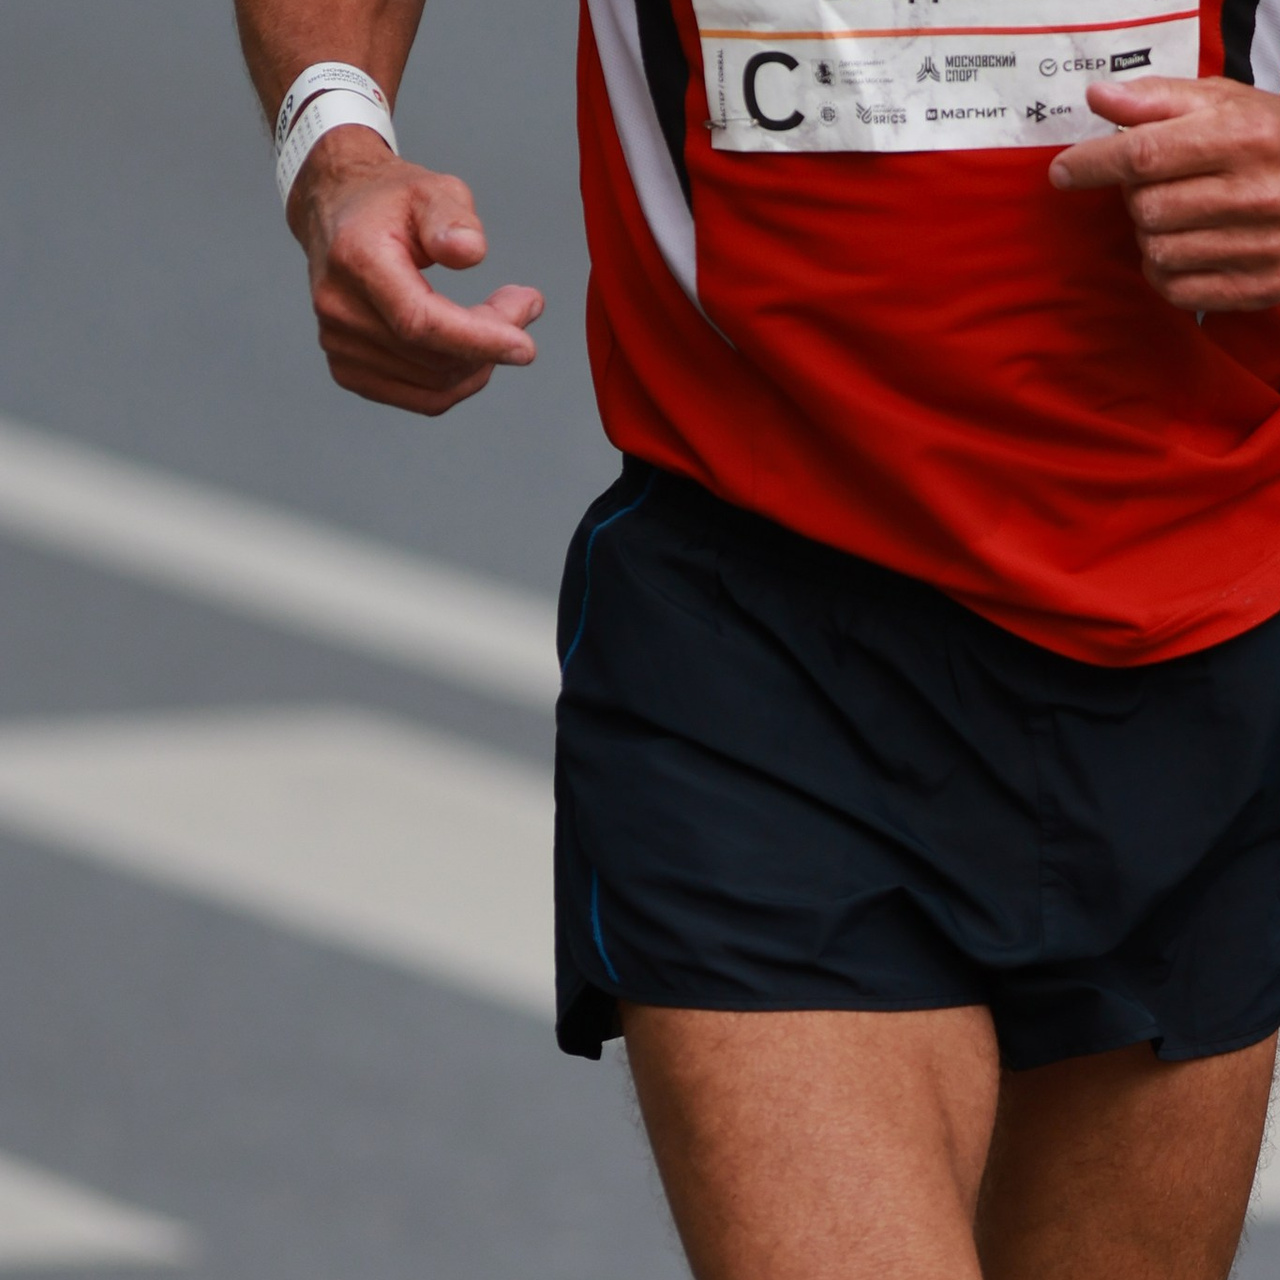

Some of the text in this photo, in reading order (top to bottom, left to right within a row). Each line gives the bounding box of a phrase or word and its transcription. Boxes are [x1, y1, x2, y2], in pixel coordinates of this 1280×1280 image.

[945, 51, 1016, 68] МОСКОВСКИЙ
[1062, 53, 1145, 72] СБЕР Прайм
[945, 68, 978, 83] СПОРТ
